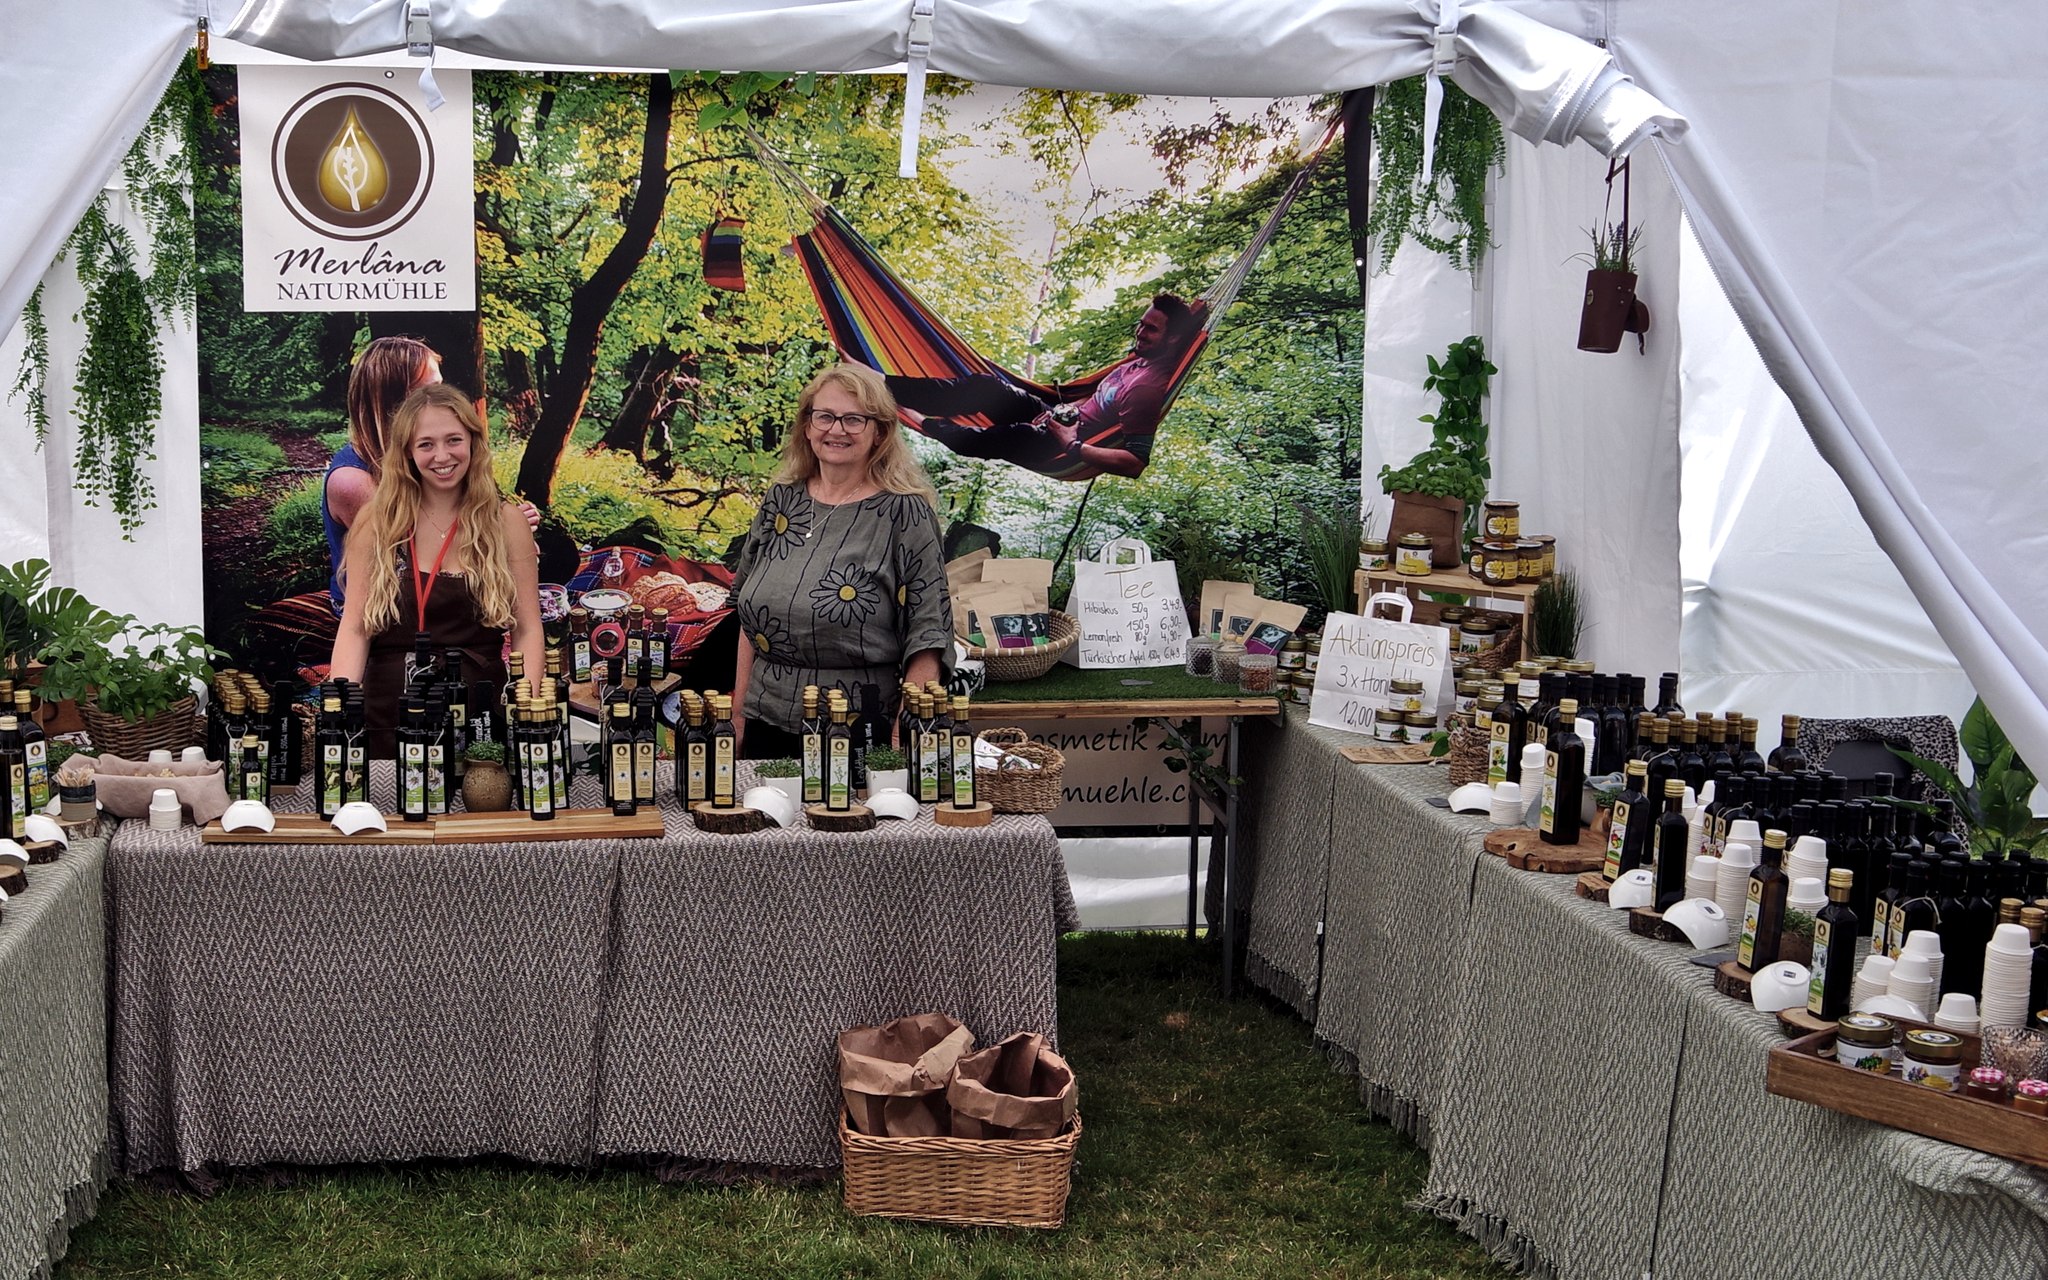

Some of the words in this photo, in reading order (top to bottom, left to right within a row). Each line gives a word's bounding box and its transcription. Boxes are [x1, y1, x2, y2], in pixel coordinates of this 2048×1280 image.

[273, 241, 446, 276] Mevlâna
[276, 278, 448, 301] NATURMÜHLE
[1104, 566, 1155, 599] Tee
[1083, 602, 1119, 615] Hibiskus
[1131, 601, 1149, 621] 50g
[1126, 619, 1150, 636] 150g
[1329, 623, 1435, 677] Aktionspreis
[1339, 700, 1374, 728] 12,00
[1062, 776, 1192, 804] muehle.c
